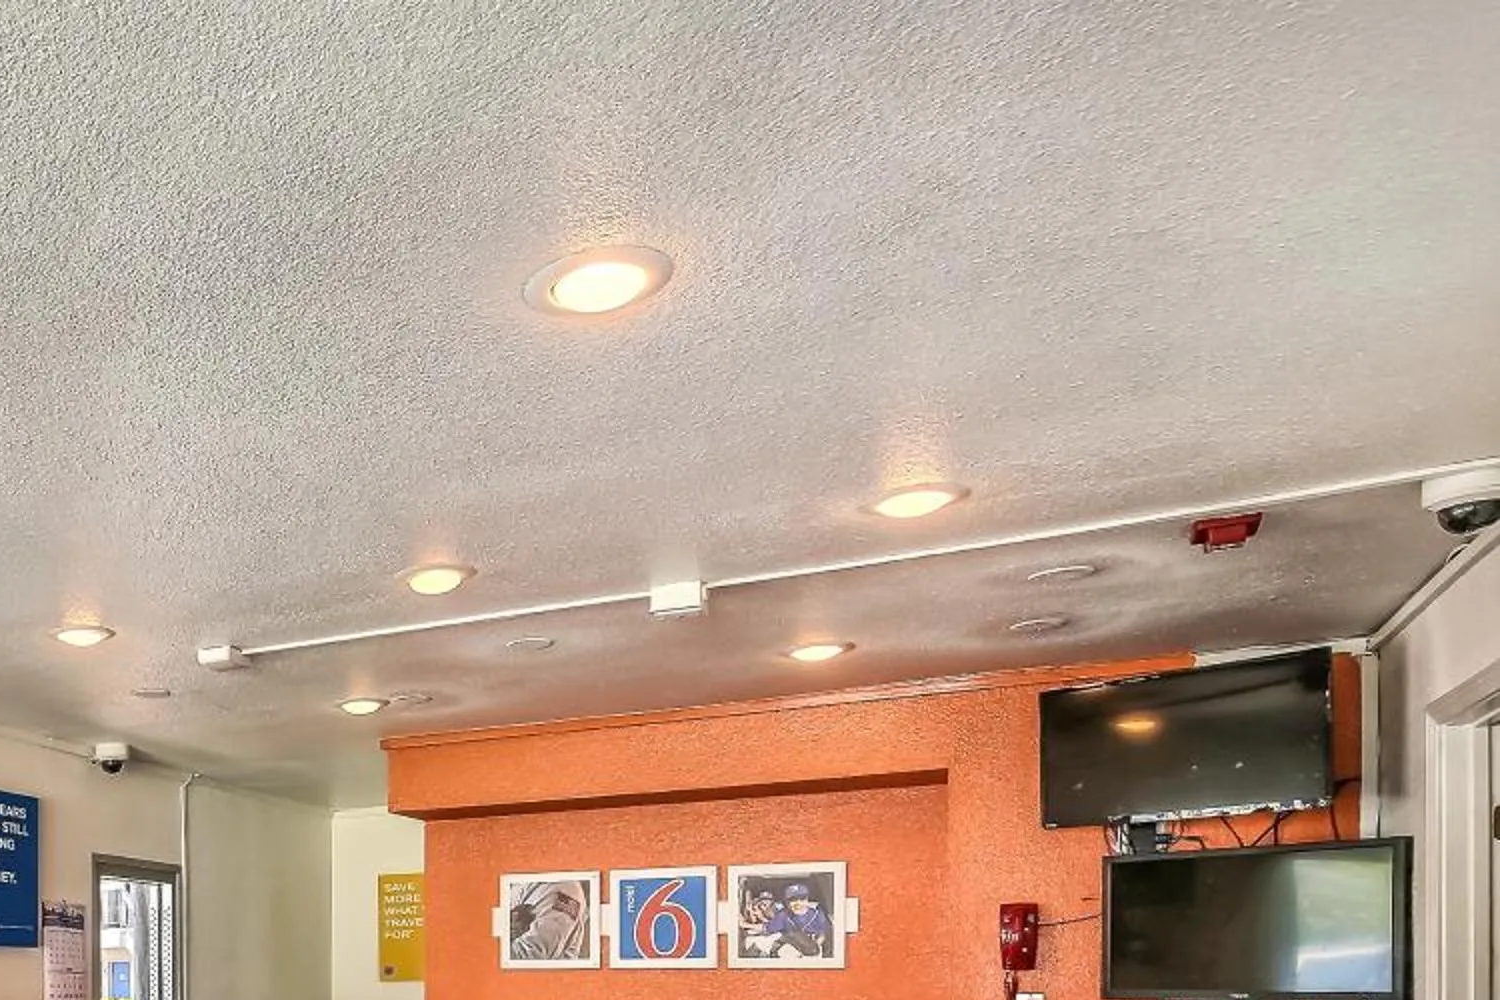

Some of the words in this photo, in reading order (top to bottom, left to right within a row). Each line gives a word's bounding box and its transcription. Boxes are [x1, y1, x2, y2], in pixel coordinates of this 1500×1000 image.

[1, 821, 29, 836] STILL
[385, 905, 419, 916] WHAT
[386, 917, 424, 927] TRAVE
[633, 879, 696, 960] 6
